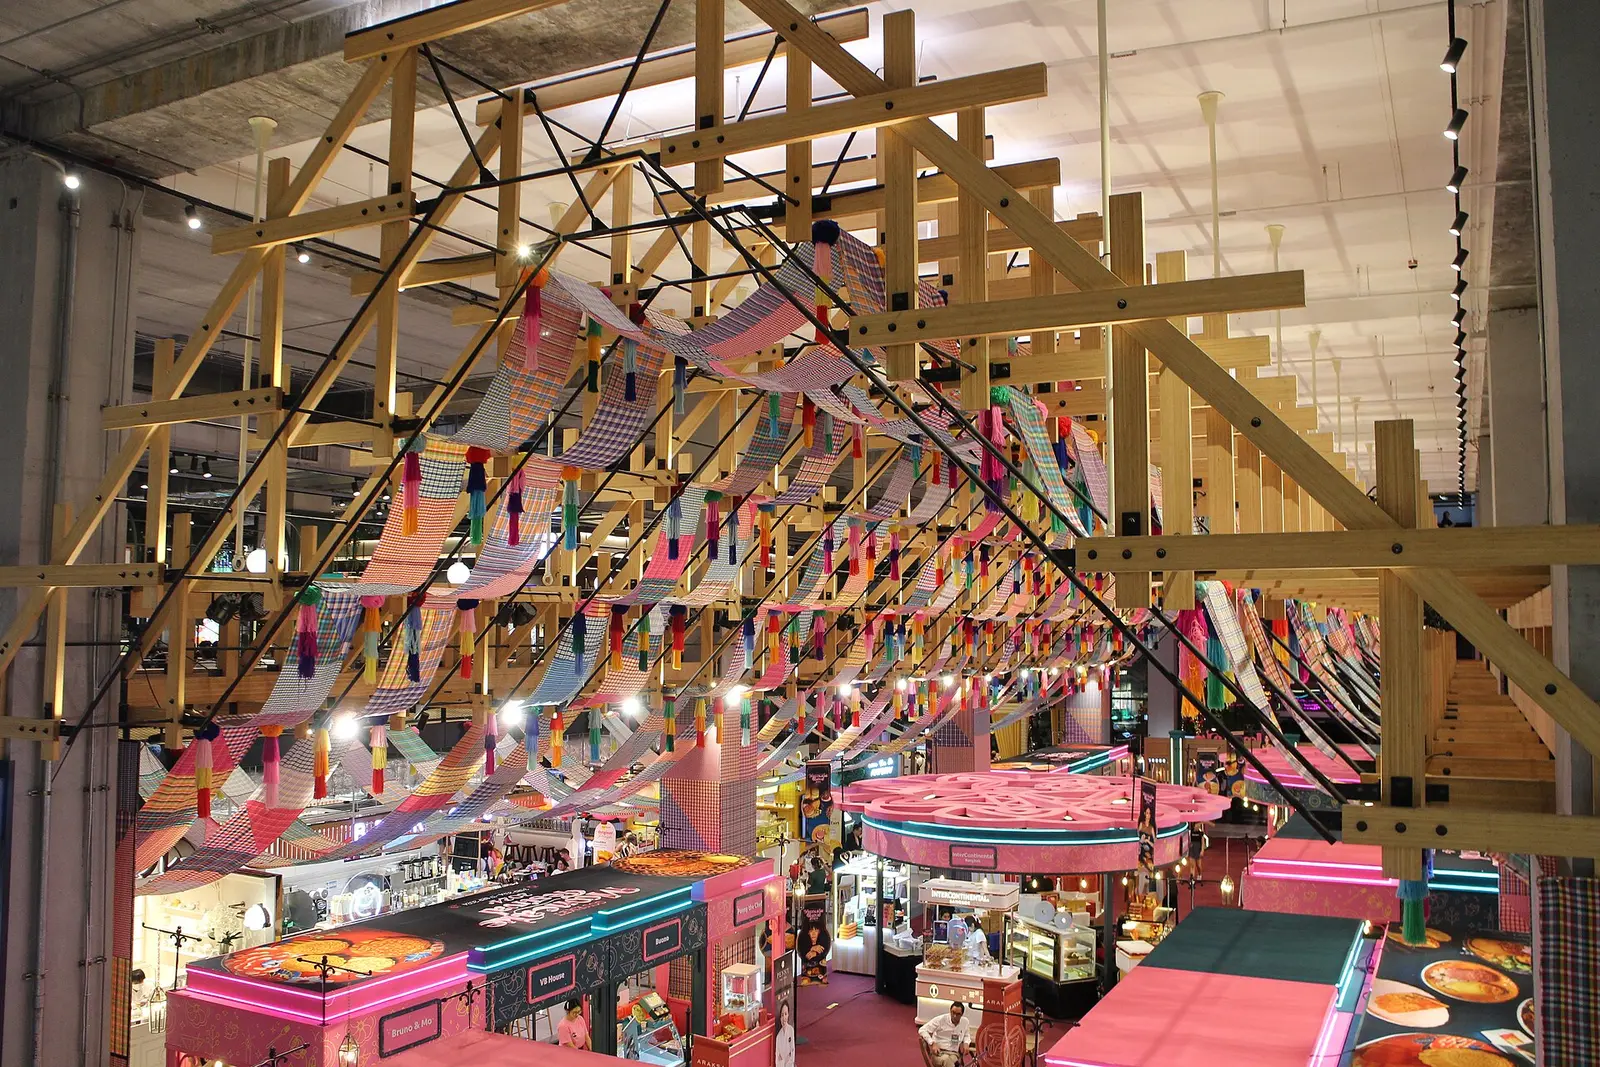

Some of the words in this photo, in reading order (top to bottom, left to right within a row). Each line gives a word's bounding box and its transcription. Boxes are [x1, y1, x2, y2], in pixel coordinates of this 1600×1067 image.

[539, 977, 548, 987] VB
[548, 972, 565, 984] House
[391, 1024, 413, 1038] Bruno
[413, 1022, 420, 1030] &
[421, 1018, 433, 1028] Mo
